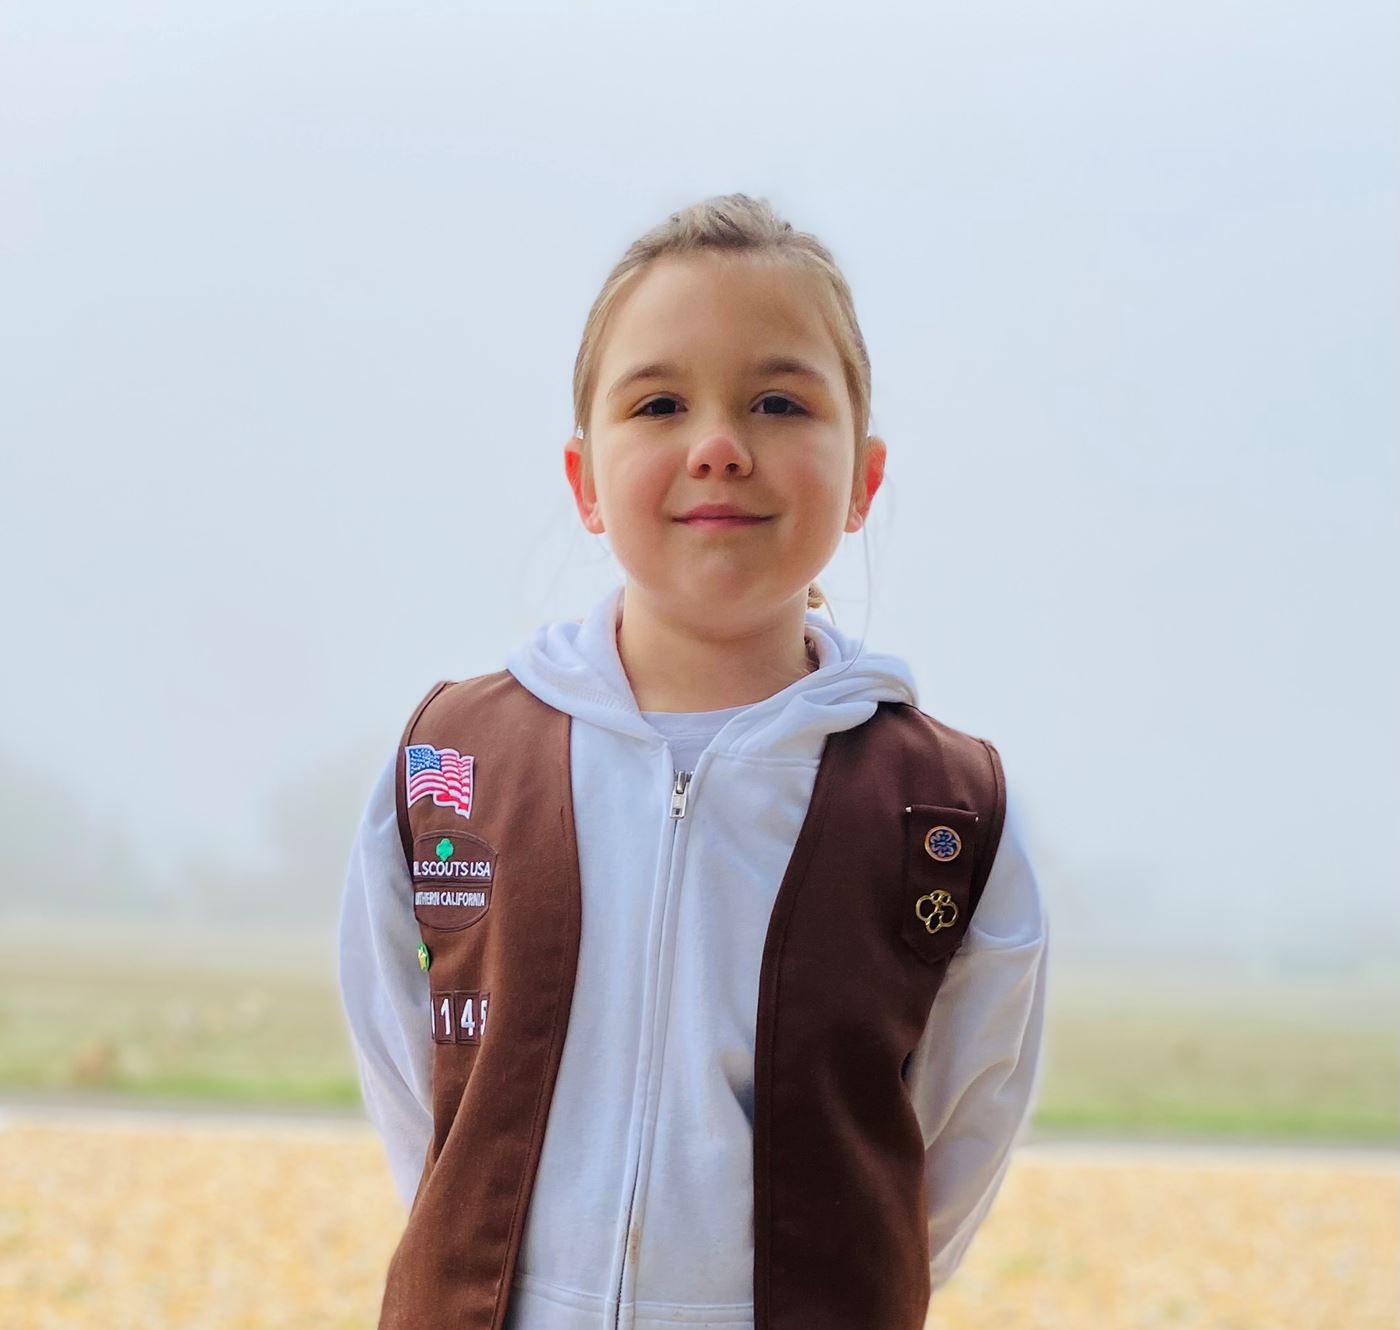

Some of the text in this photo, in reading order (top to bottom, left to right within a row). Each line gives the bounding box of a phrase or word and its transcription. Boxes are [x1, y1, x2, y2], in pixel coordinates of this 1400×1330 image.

[421, 861, 468, 877] SCOUTS
[470, 861, 491, 877] USA
[440, 892, 485, 907] CALIFORNIA
